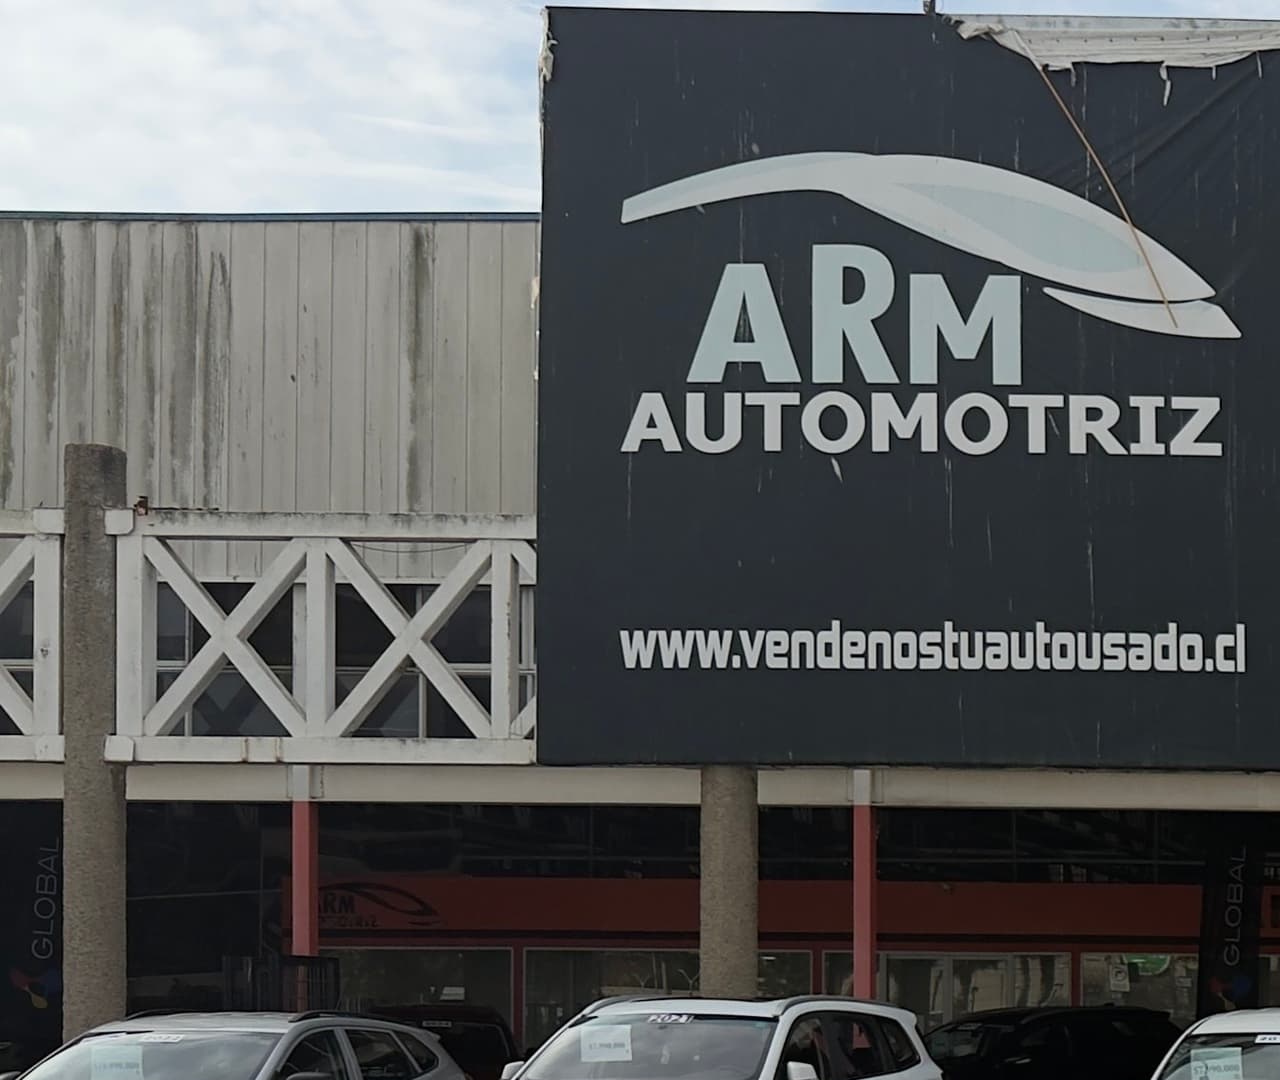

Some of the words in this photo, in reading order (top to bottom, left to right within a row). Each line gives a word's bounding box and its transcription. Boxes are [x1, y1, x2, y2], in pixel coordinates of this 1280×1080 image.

[687, 244, 1023, 386] ARM
[621, 391, 1223, 456] AUTOMOTRIZ
[620, 620, 1246, 673] www.vendenostuautousado.cl
[32, 837, 59, 959] GLOBAL
[319, 893, 356, 914] RM
[1223, 846, 1247, 966] GLOBAL
